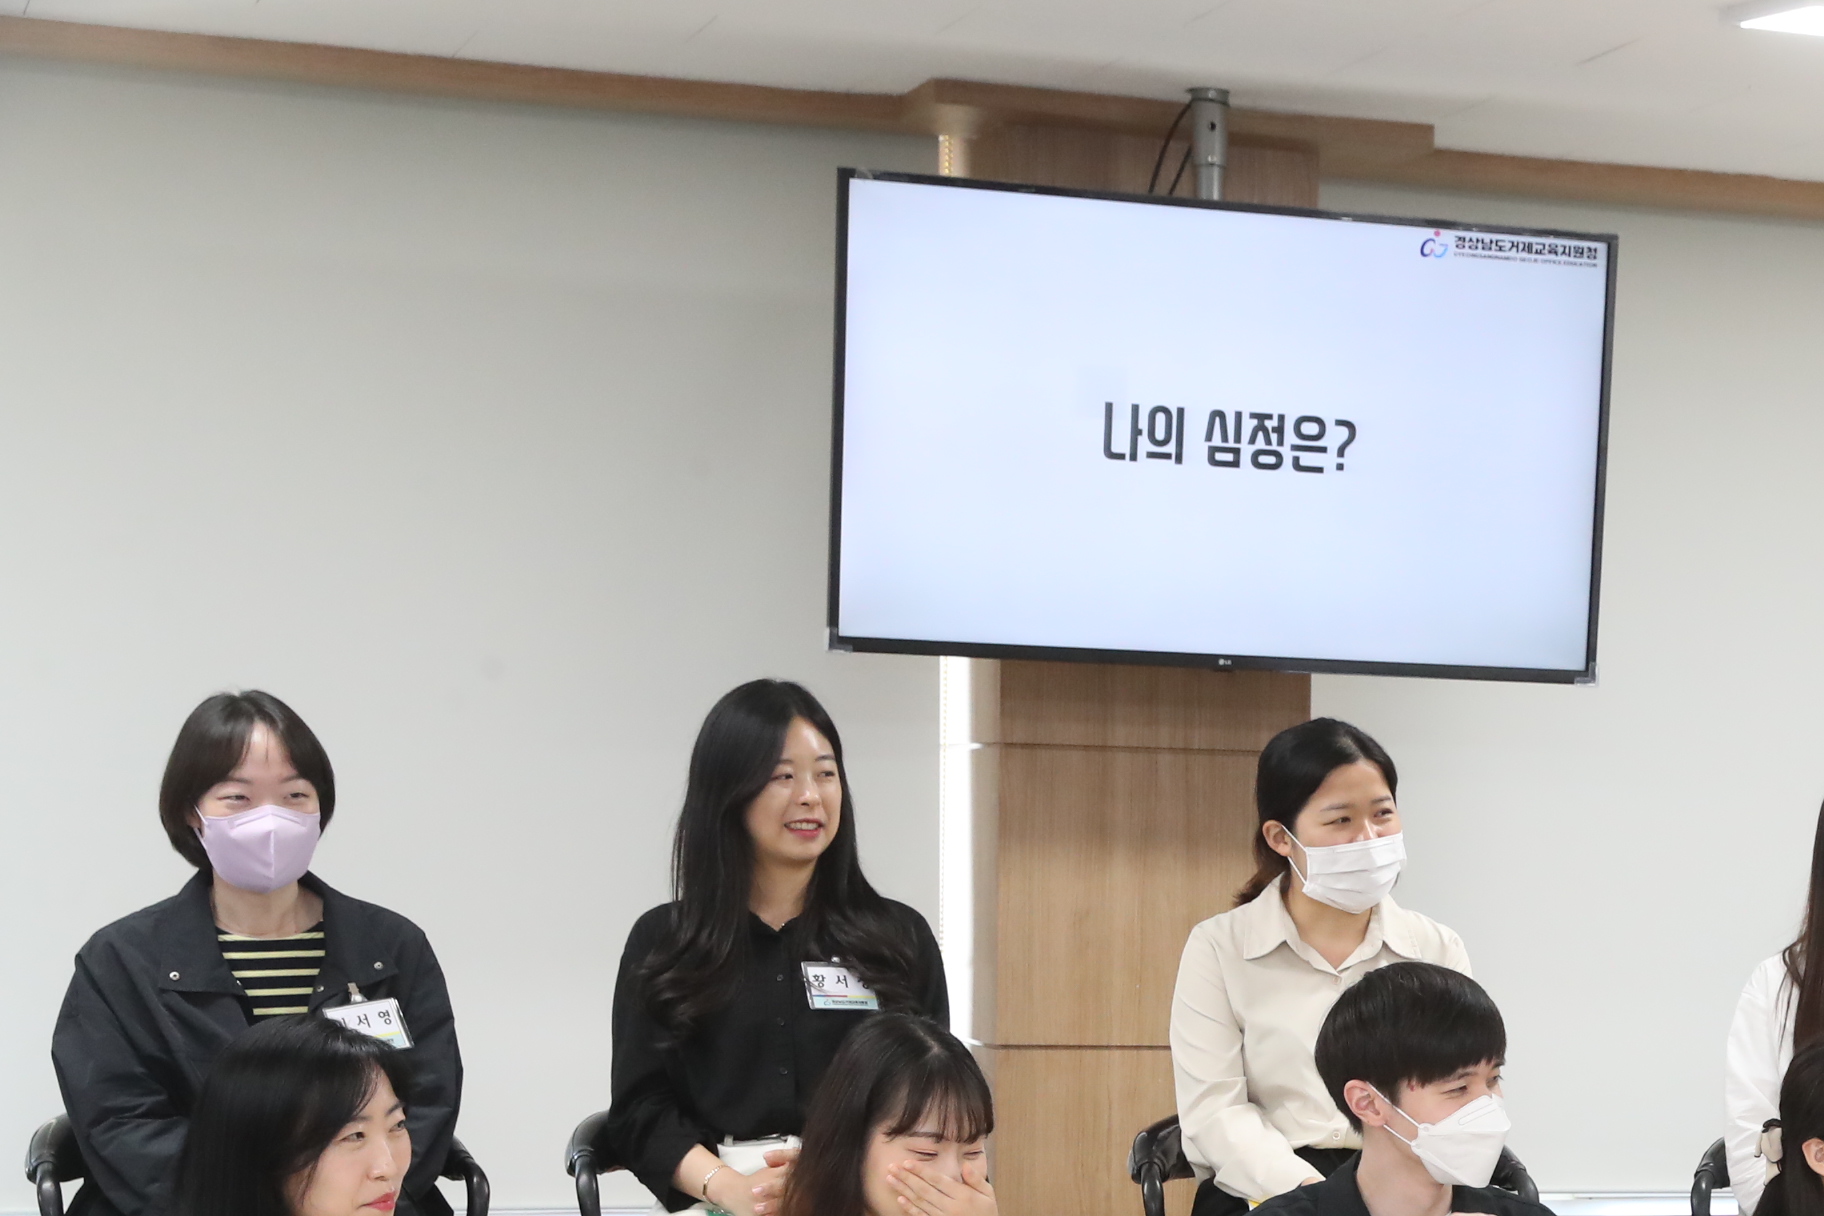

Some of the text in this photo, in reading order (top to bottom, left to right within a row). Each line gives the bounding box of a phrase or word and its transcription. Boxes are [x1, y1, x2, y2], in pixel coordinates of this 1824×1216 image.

[1454, 235, 1598, 260] 경상남도거제교육지원청
[1102, 401, 1357, 474] 나의 심정은?
